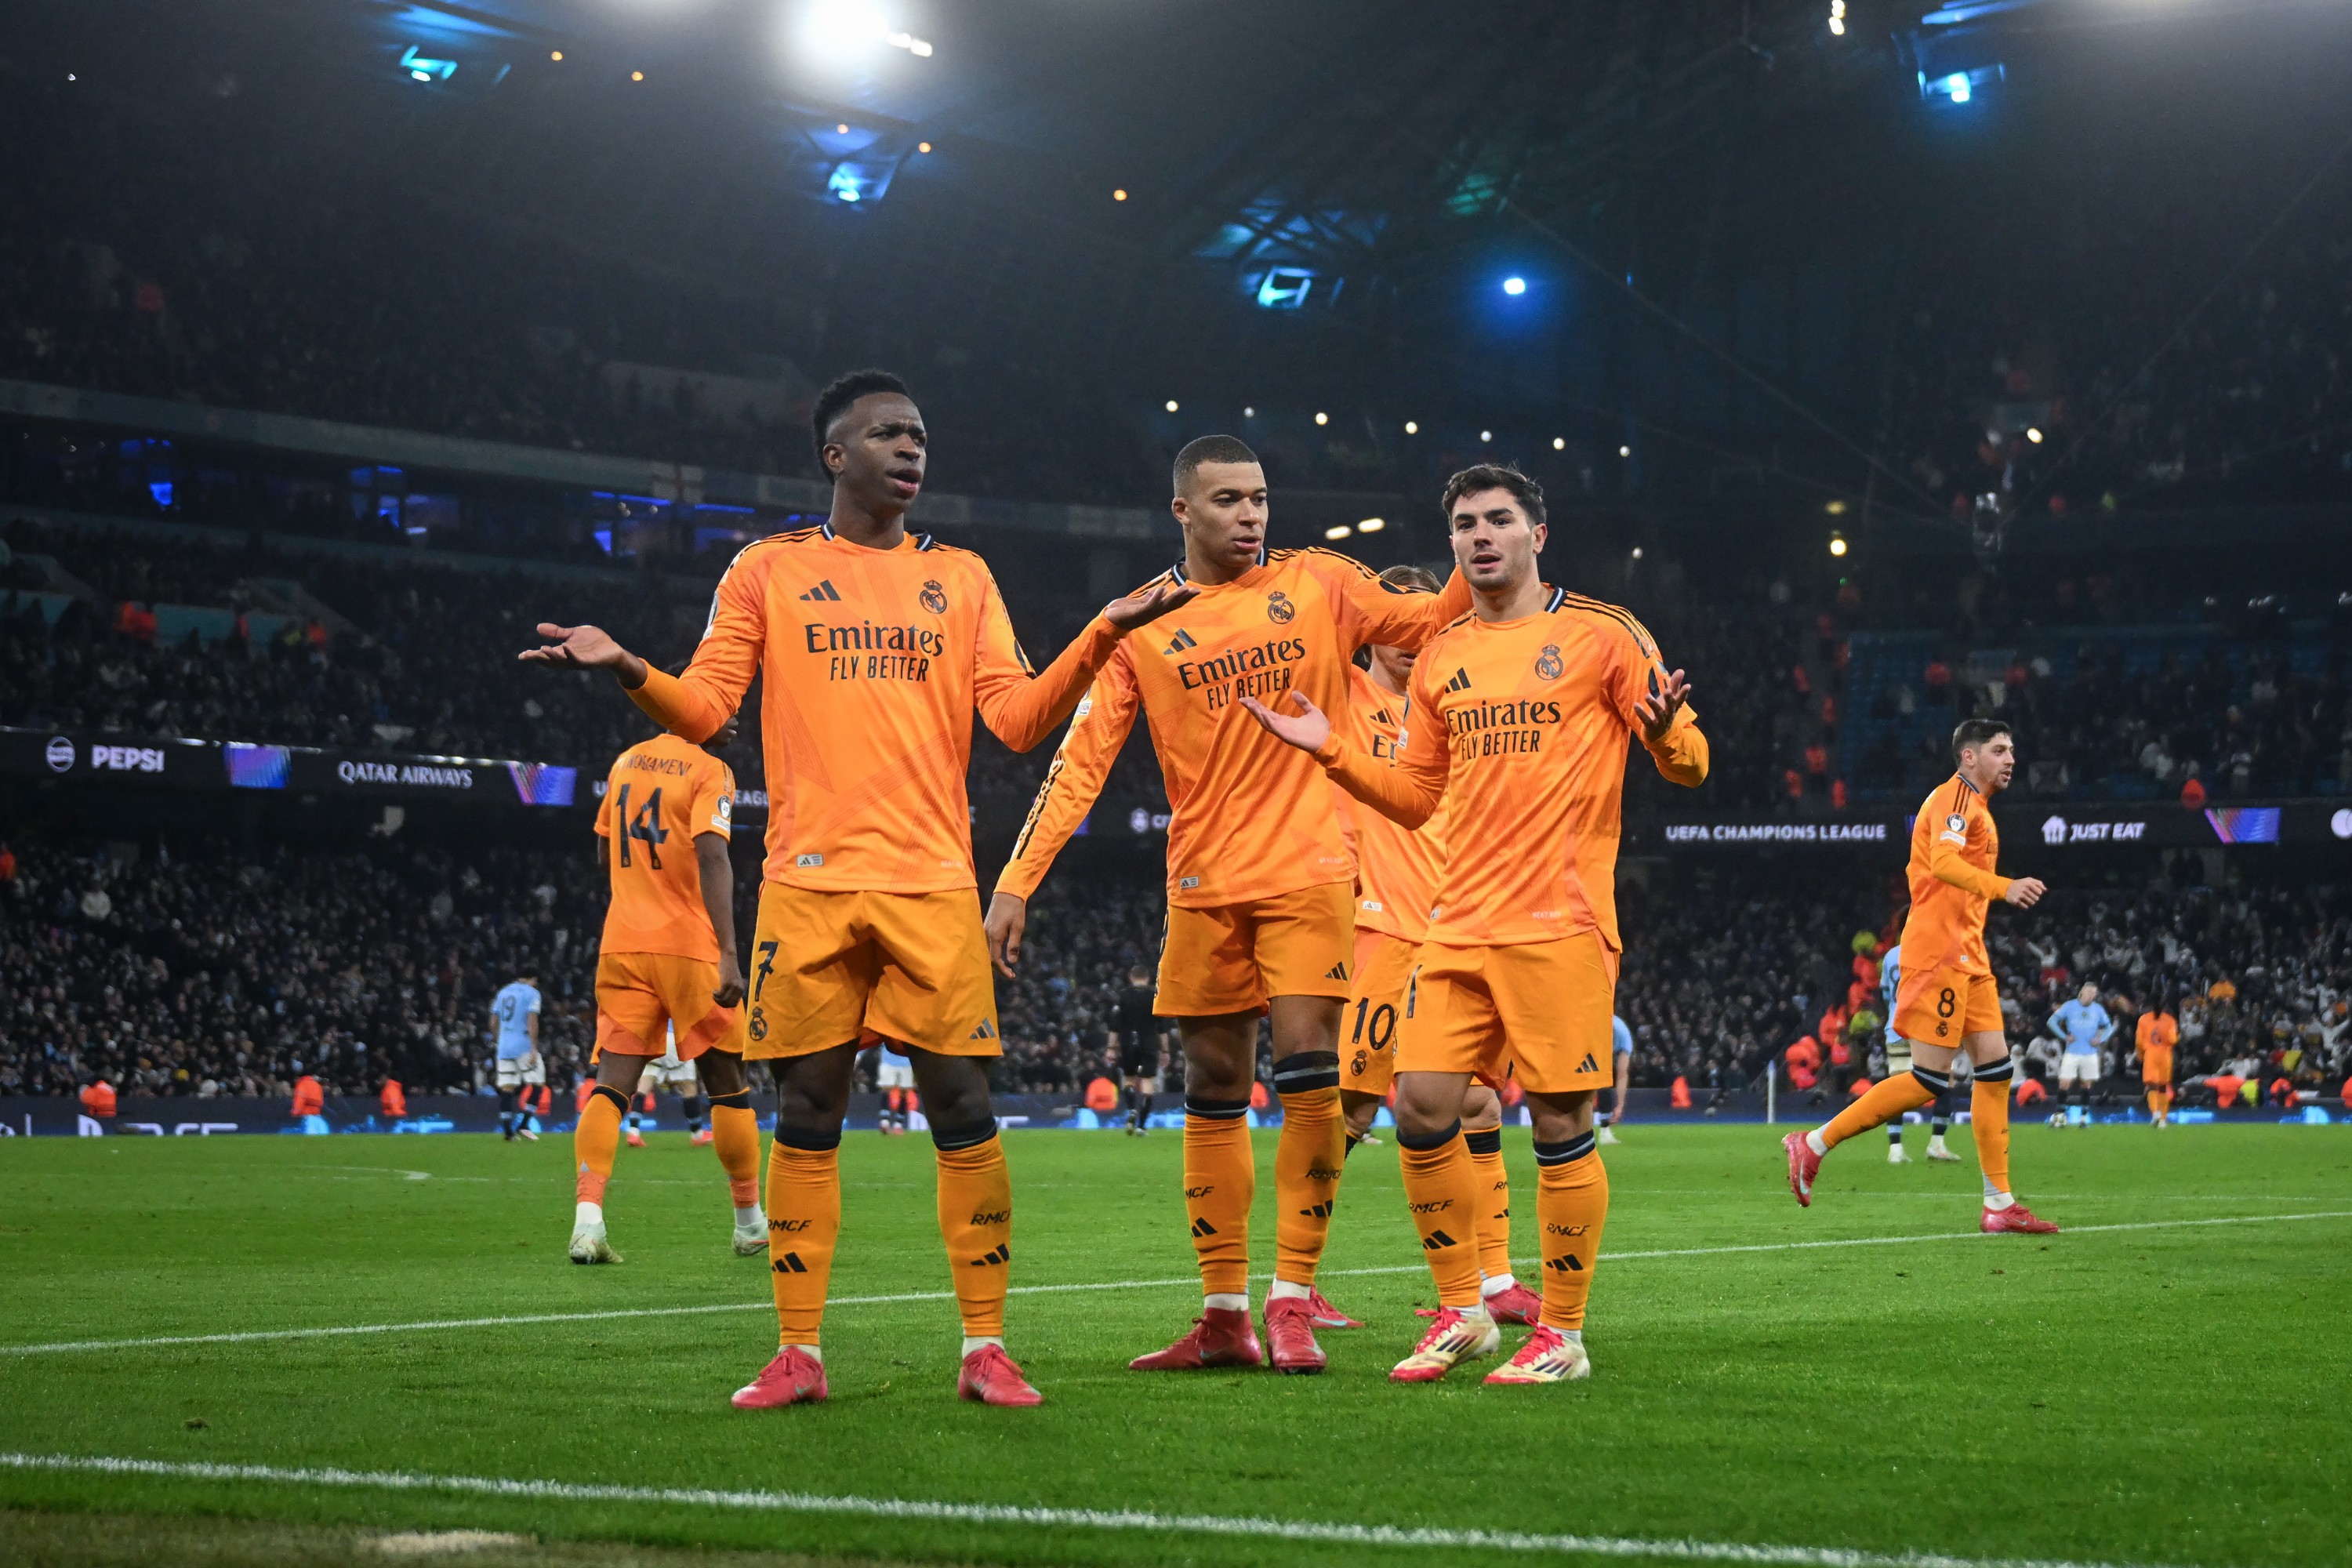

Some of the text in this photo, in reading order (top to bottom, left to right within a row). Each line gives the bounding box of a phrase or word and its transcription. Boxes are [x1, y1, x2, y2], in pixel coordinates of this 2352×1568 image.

[804, 620, 944, 657] Emirates
[830, 655, 929, 682] FLY BETTER
[1177, 637, 1305, 690] Emirates
[1207, 667, 1291, 710] FLY BETTER
[1446, 699, 1561, 737] Emirates
[91, 745, 165, 772] PEPSI
[1461, 730, 1541, 761] FLY BETTER
[338, 760, 473, 789] QATAR AIRWAYS
[616, 784, 670, 869] 14
[1665, 824, 1886, 841] UEFA CHAMPIONS LEAGUE
[2070, 822, 2146, 841] JUST EAT
[754, 942, 778, 1001] 7
[1937, 987, 1955, 1018] 8
[1352, 996, 1396, 1051] 10
[1547, 1222, 1590, 1237] RMCF
